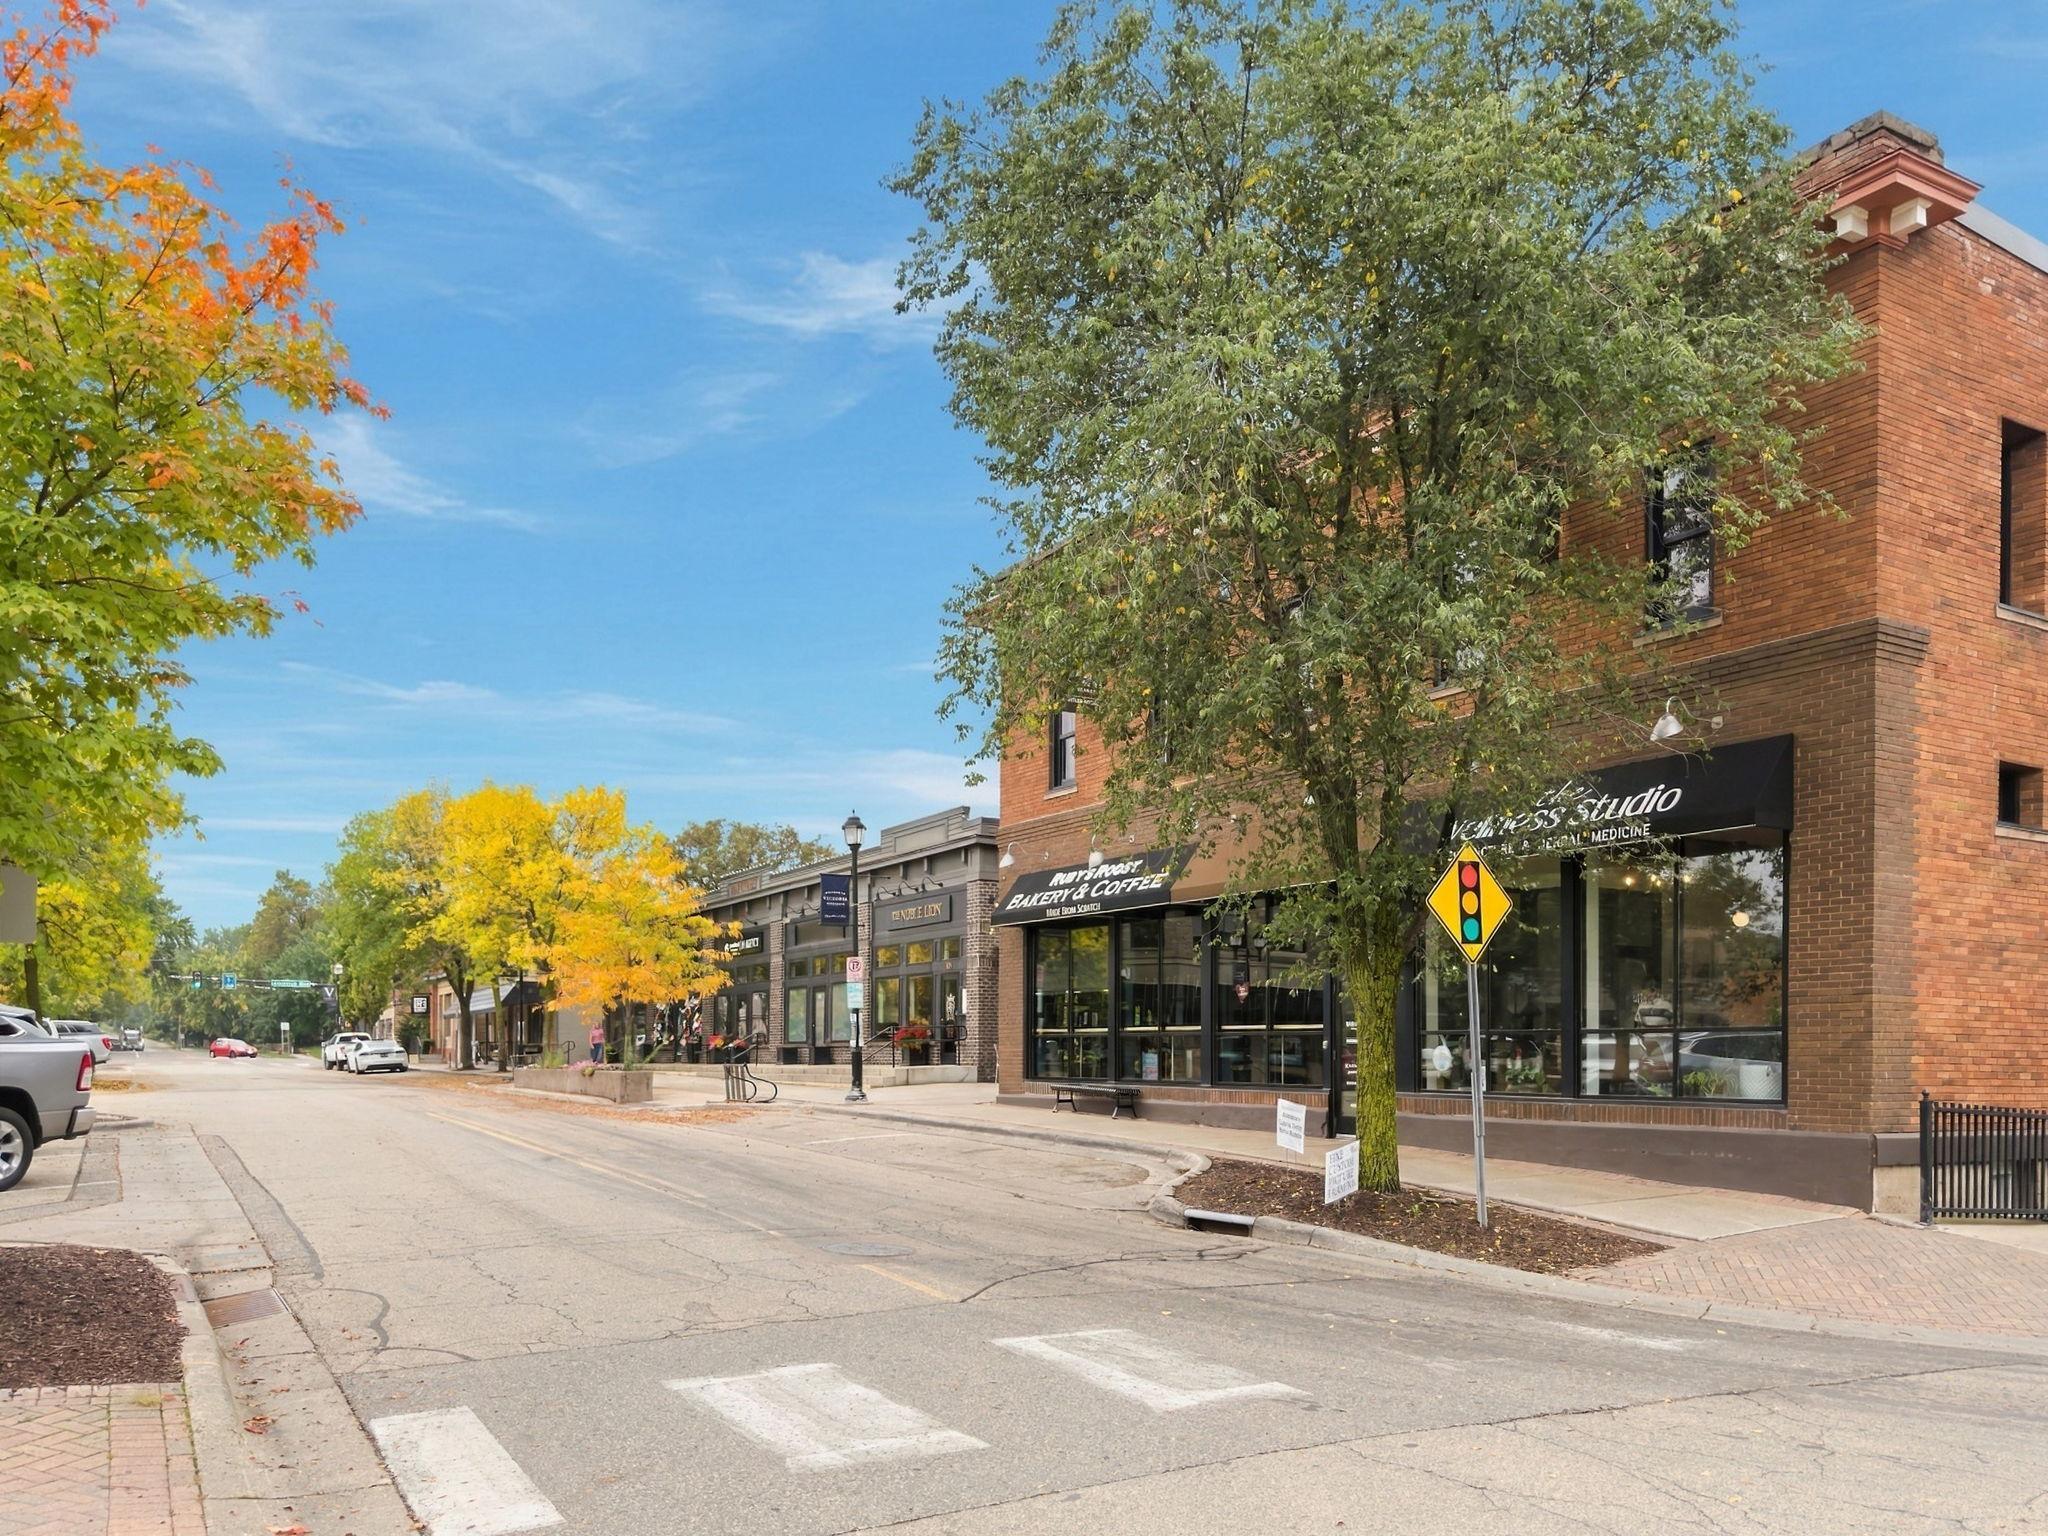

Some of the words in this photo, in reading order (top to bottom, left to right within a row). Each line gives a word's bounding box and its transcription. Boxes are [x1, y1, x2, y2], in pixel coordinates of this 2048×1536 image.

[1591, 823, 1652, 843] MEDICINE
[1005, 887, 1076, 911] BAKERY
[1072, 882, 1090, 901] &
[1090, 872, 1170, 897] COFFEE
